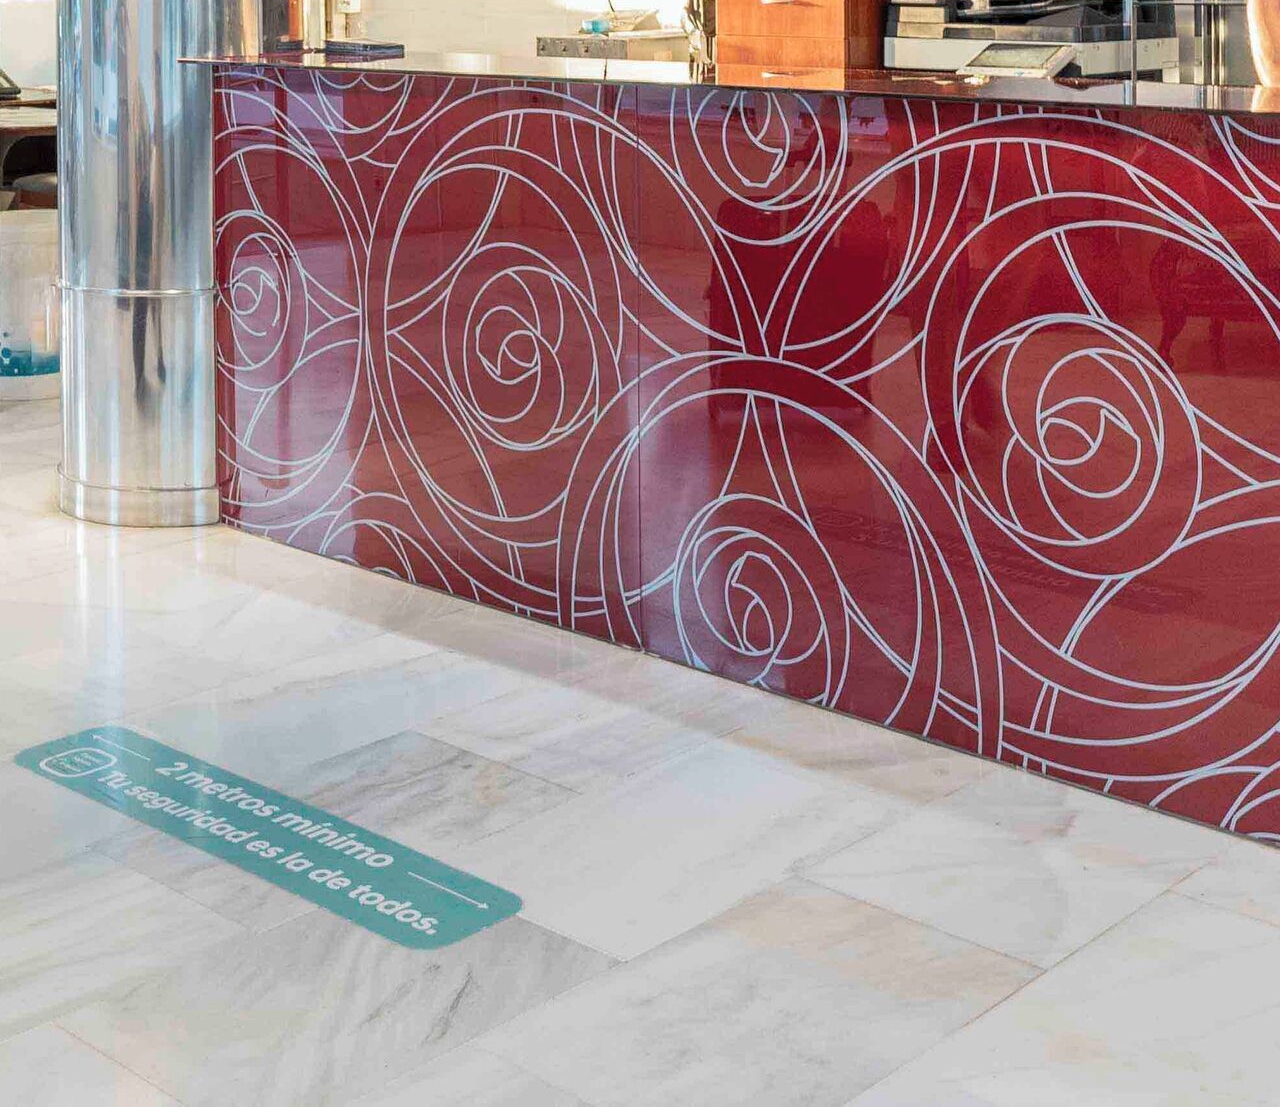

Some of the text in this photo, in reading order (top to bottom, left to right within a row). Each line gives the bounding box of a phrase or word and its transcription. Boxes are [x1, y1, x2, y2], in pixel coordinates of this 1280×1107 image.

[96, 769, 439, 935] Tu seguridad es la de todos.
[154, 761, 189, 776] 2
[175, 771, 280, 817] metros
[271, 812, 394, 868] mínimo
